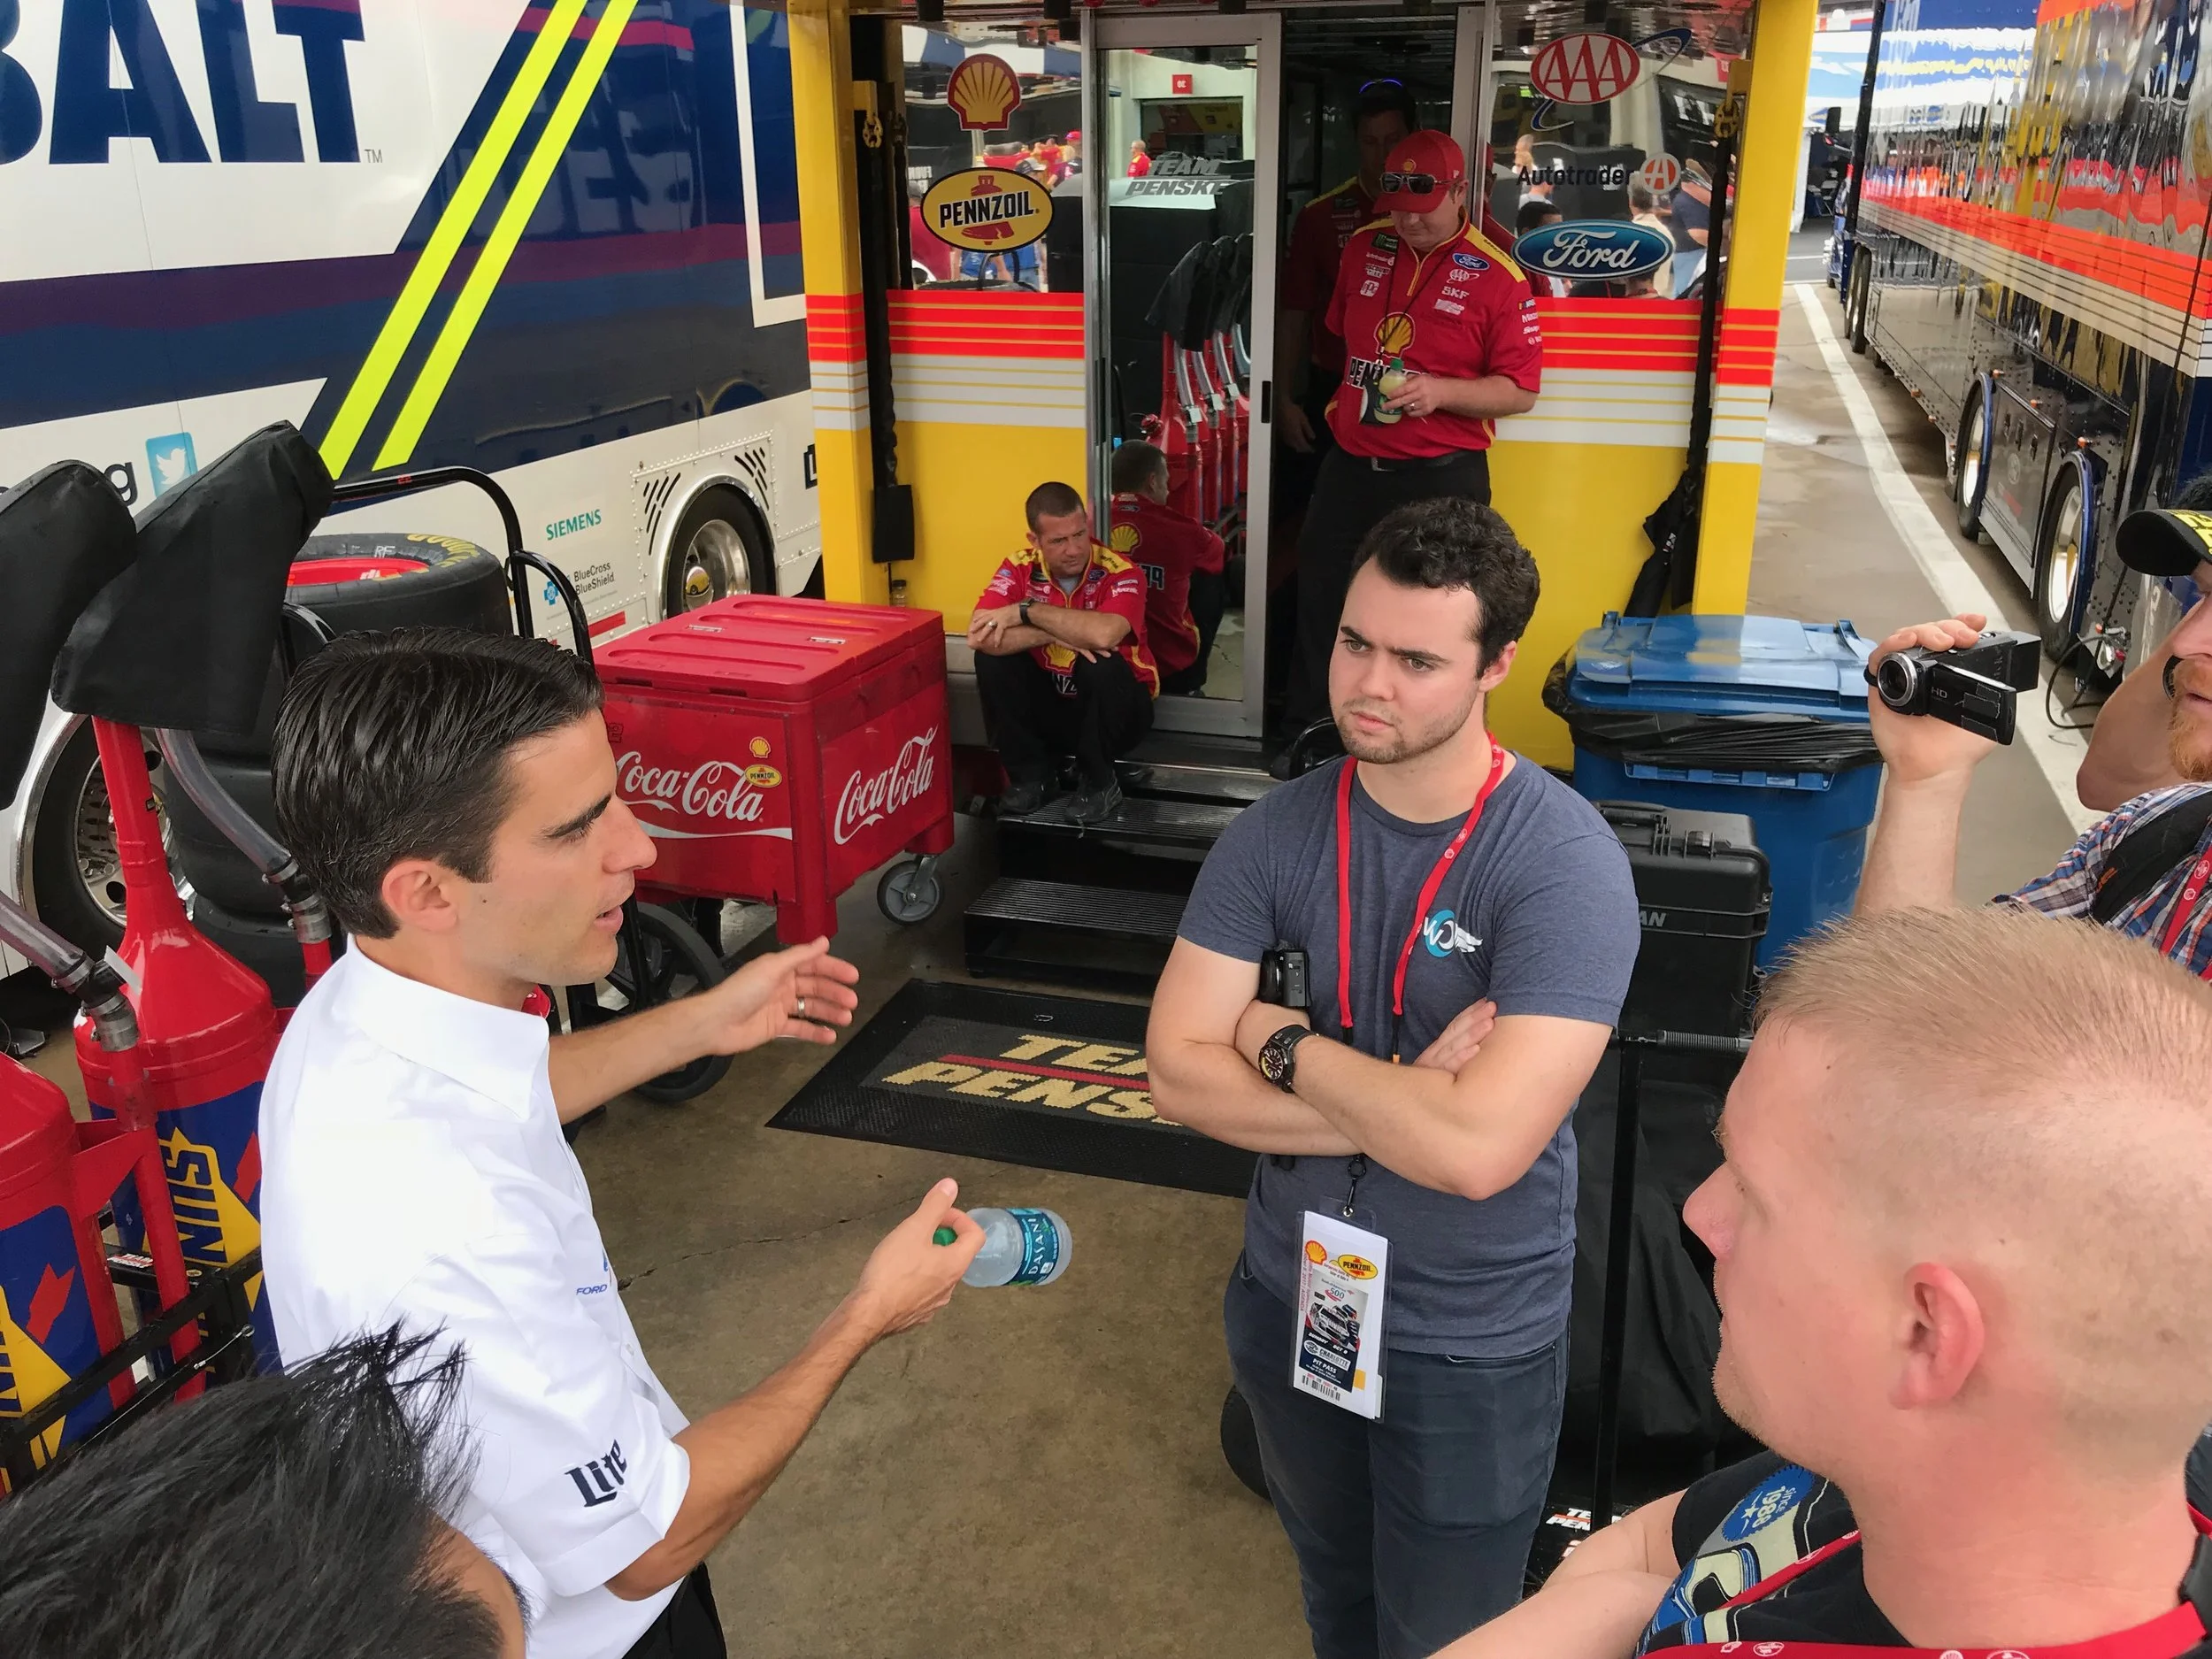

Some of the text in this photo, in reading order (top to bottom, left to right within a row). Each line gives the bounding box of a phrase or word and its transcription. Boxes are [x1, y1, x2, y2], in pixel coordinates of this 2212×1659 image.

[1542, 34, 1630, 103] AAA
[1148, 159, 1222, 175] TEAM
[1516, 165, 1635, 187] Autotrader
[1125, 180, 1232, 196] PENSKE
[940, 190, 1034, 229] PENNZOIL
[1543, 228, 1640, 269] Ford
[1441, 286, 1470, 299] SKF
[546, 509, 602, 541] SIEMENS
[573, 562, 611, 582] BlueCross
[575, 572, 615, 595] BlueShield
[1931, 687, 1948, 699] HD
[749, 772, 775, 780] PENNZOIL
[833, 723, 939, 845] Coca-Cola
[881, 1061, 1168, 1124] PENS
[1027, 1217, 1046, 1275] DASANI
[1342, 1261, 1372, 1272] PENNZOIL
[576, 1284, 608, 1296] FORD
[1330, 1287, 1345, 1299] 500
[1312, 1357, 1323, 1367] PIT
[1322, 1363, 1337, 1374] PASS
[1318, 1348, 1349, 1367] CHARLOTTE
[564, 1438, 627, 1508] Lite
[1752, 1486, 1786, 1528] 1988
